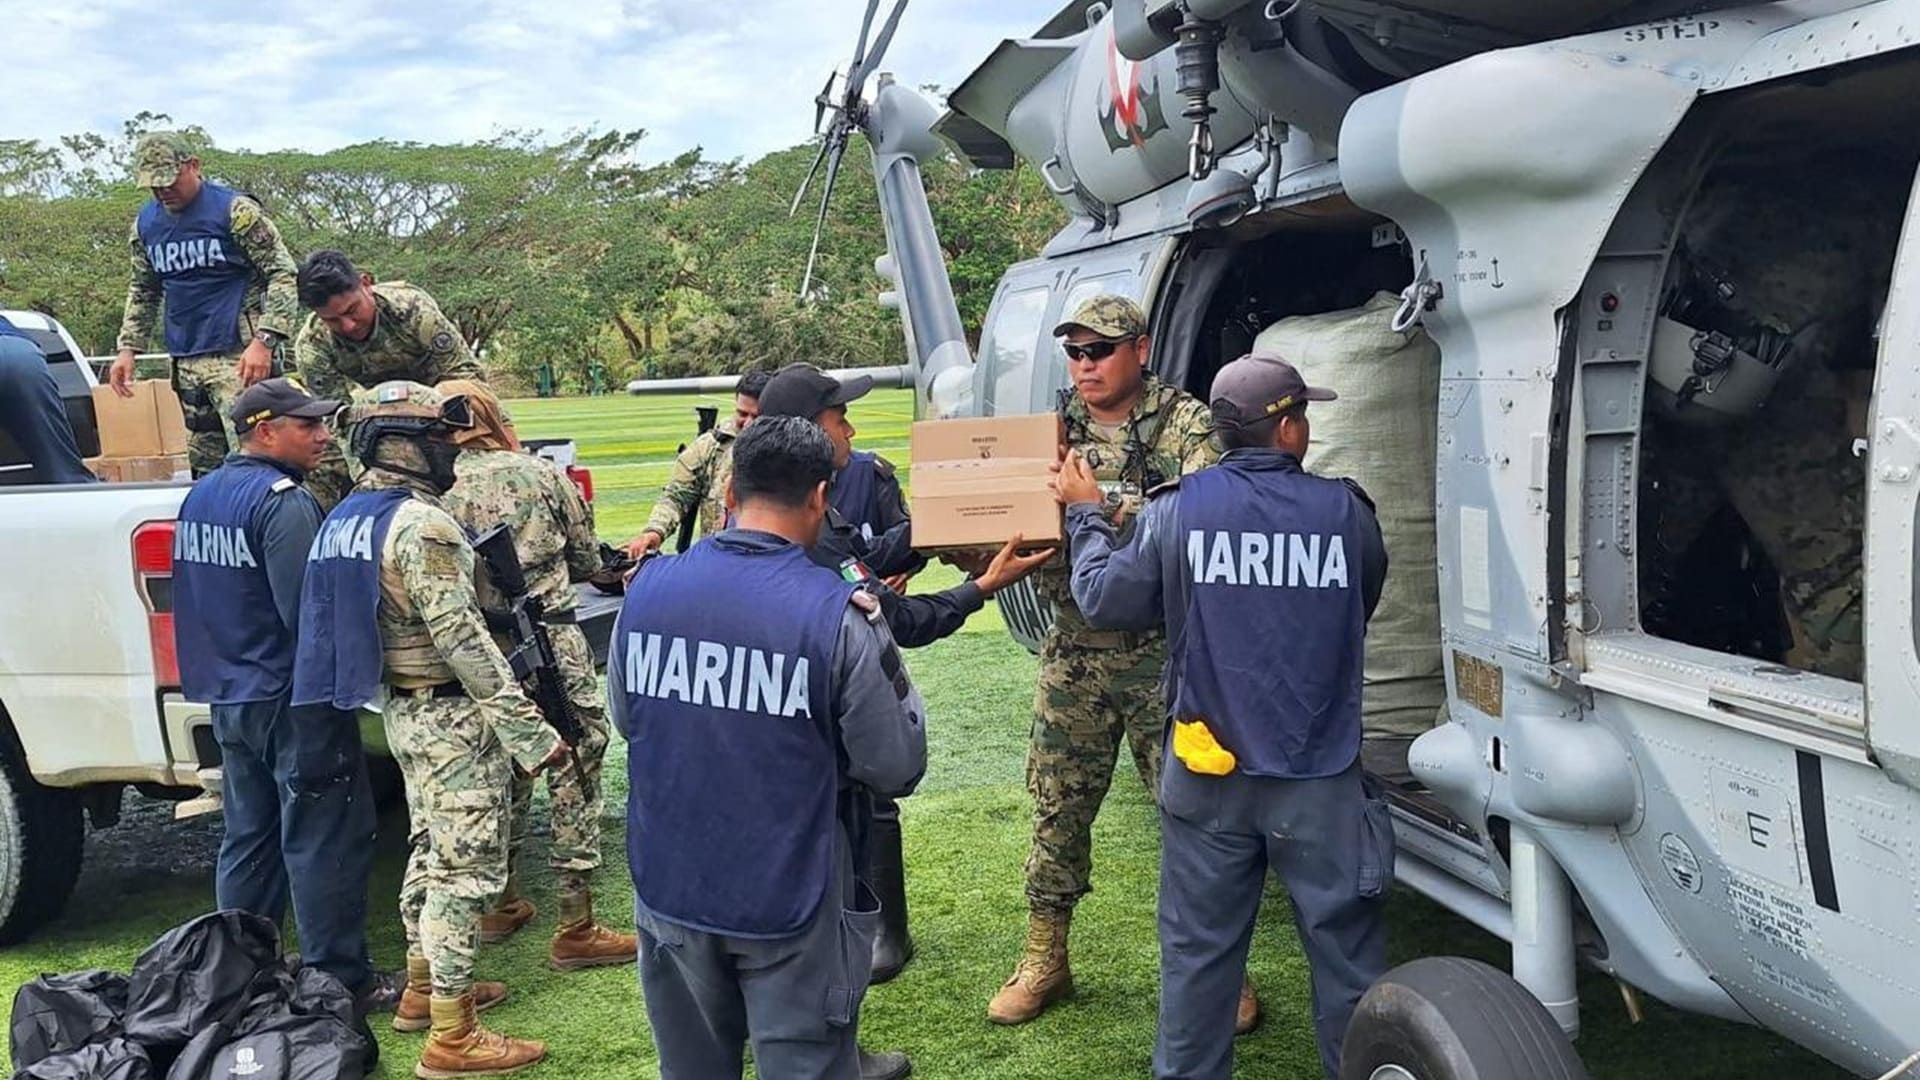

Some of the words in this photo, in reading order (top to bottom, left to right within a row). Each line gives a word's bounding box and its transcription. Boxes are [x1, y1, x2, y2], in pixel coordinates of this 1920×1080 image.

[1624, 20, 1719, 41] STEP
[626, 631, 812, 719] MARINA
[1747, 810, 1771, 849] E
